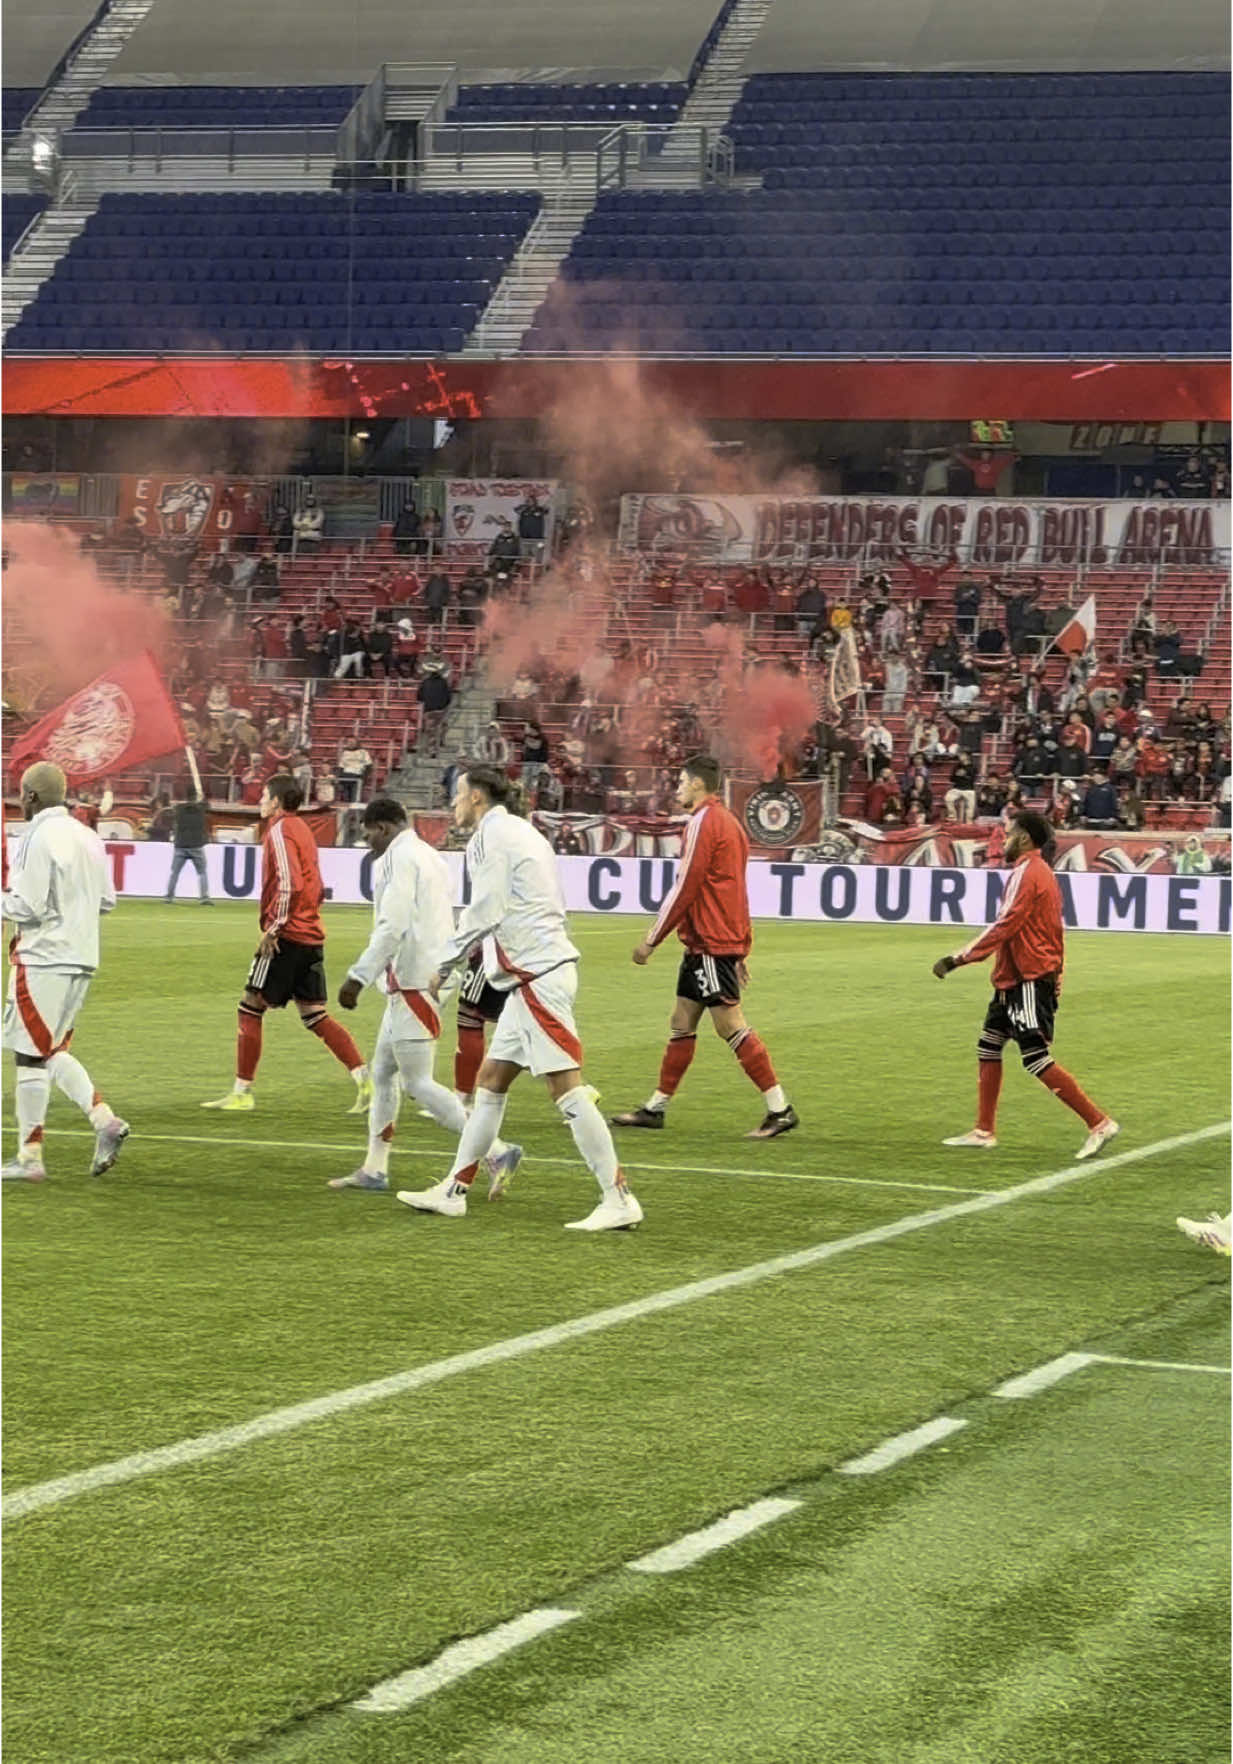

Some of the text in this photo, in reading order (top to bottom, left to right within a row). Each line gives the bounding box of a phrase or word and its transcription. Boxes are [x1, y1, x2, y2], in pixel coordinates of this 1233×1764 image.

[755, 502, 1215, 564] DEFENDERS OF RED BULL ARENA
[587, 857, 675, 912] CU
